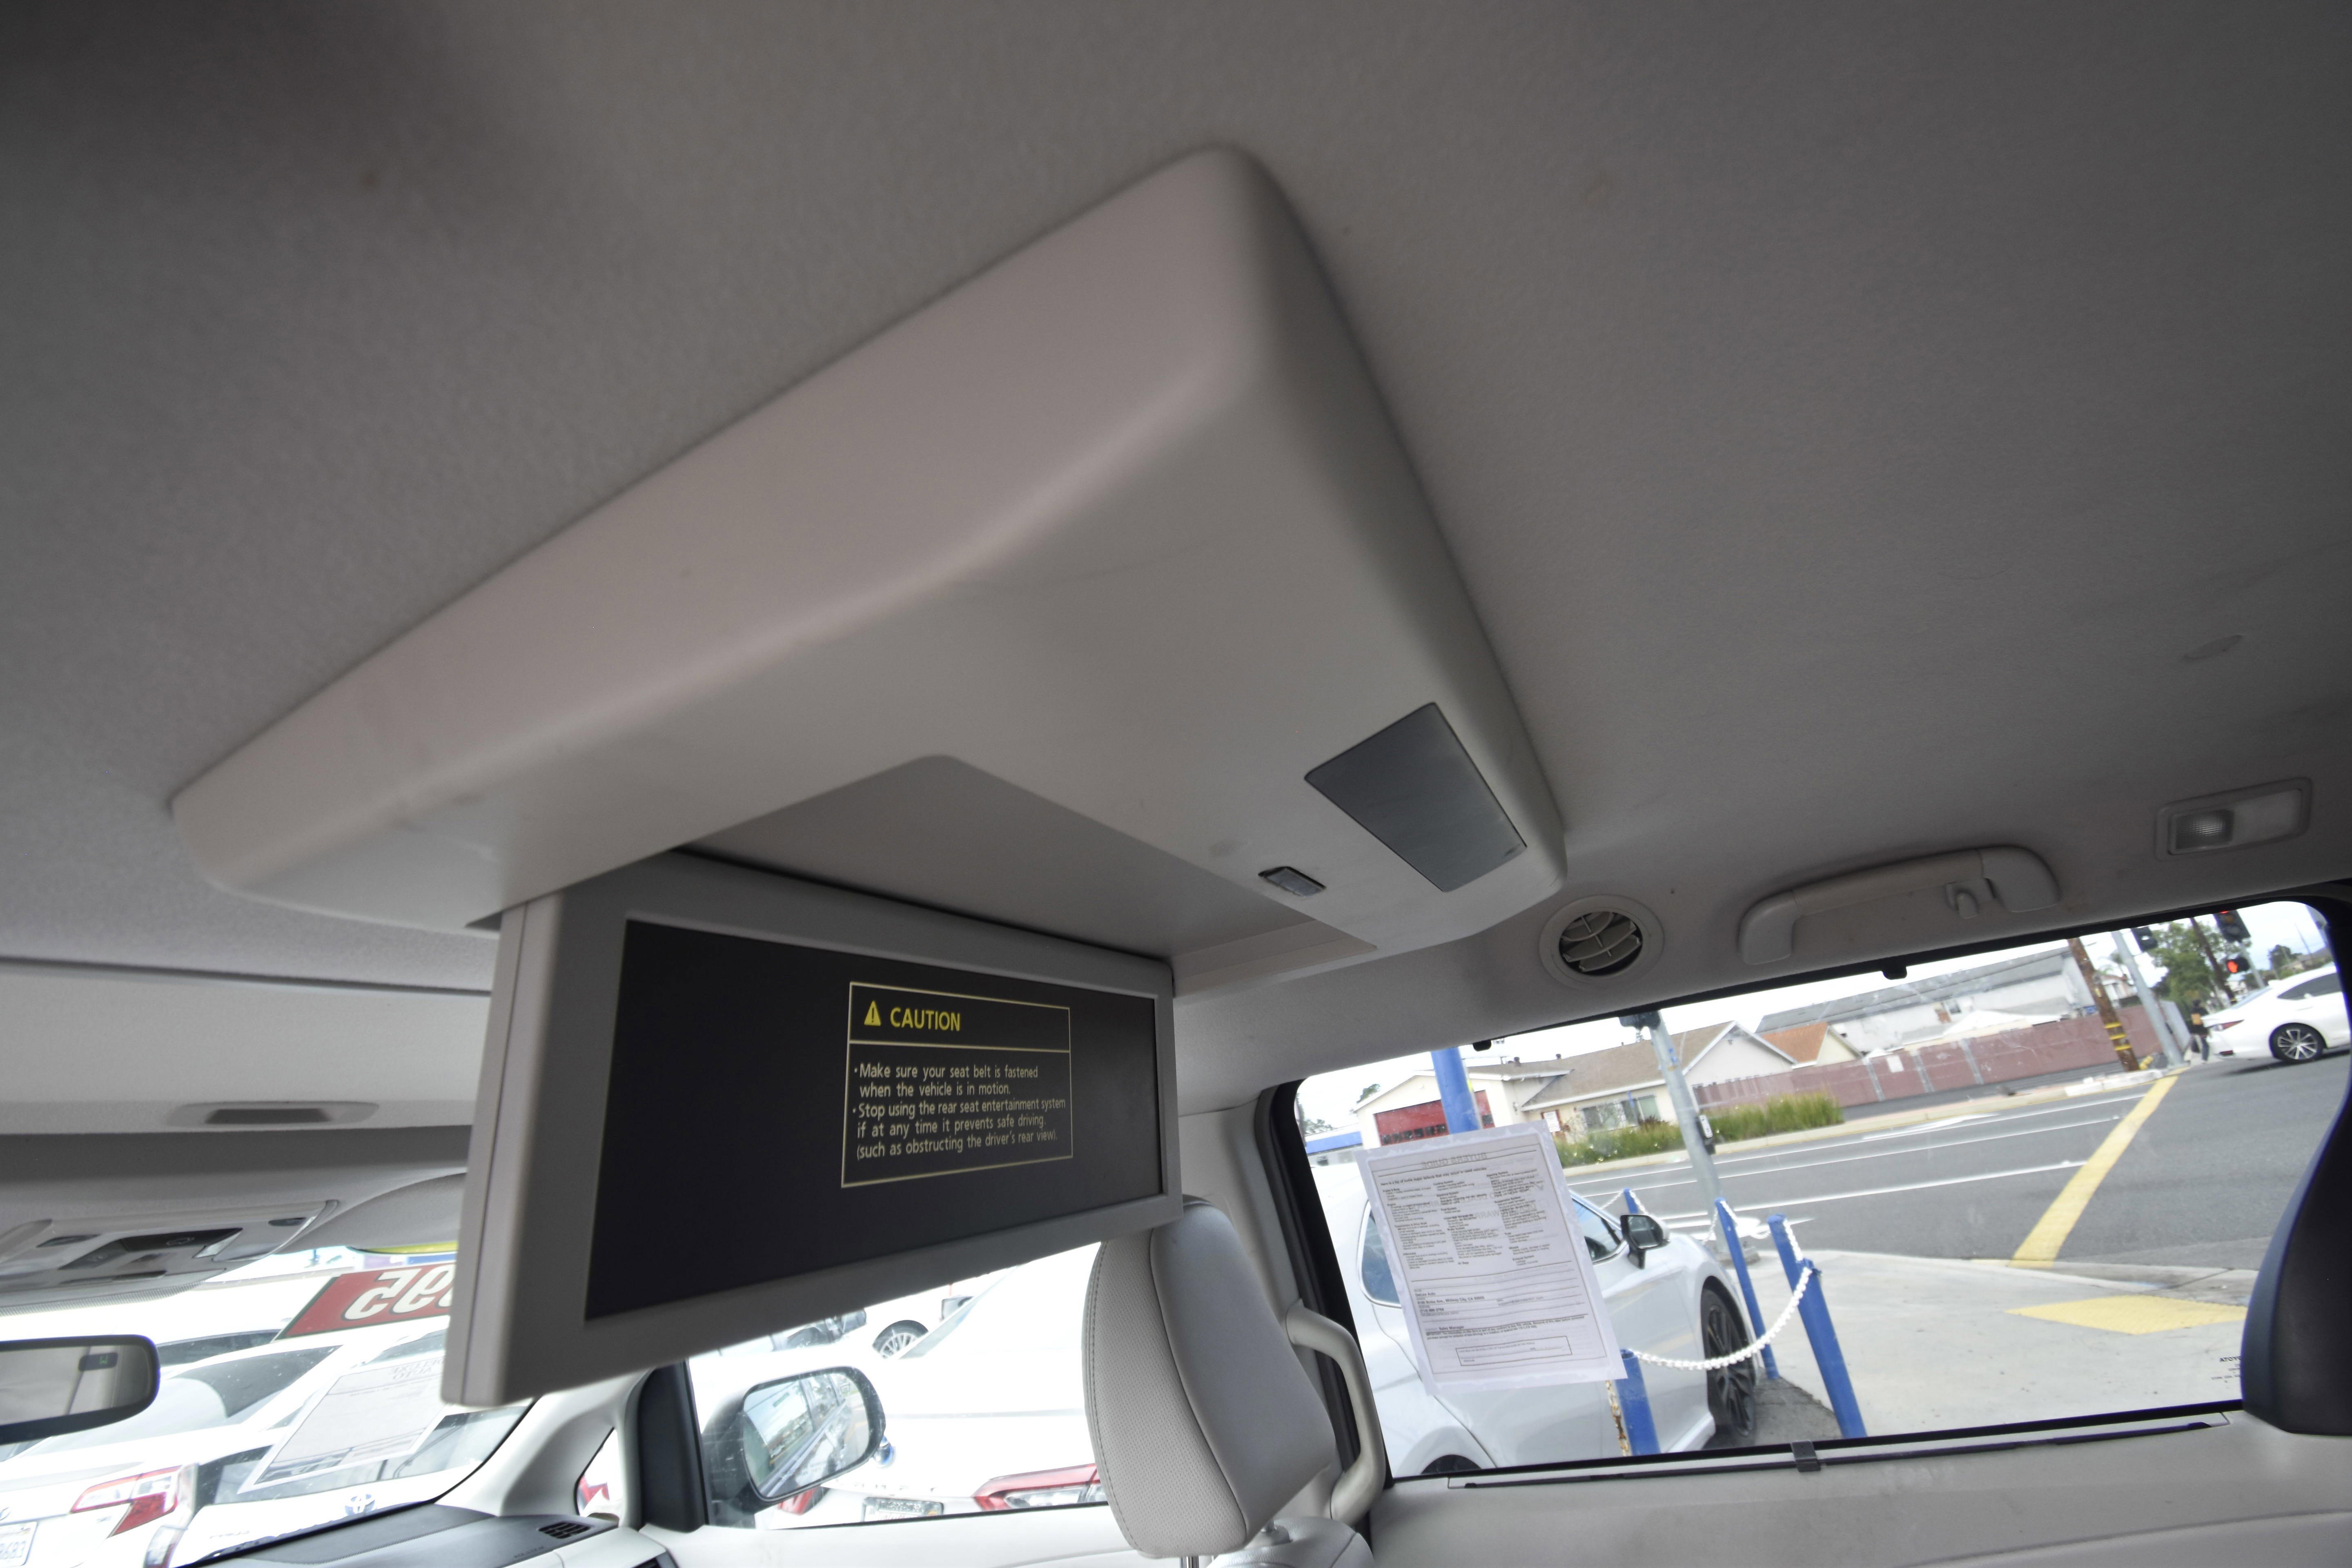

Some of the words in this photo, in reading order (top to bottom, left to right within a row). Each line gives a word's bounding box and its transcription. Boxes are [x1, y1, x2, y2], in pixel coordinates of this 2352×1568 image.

[890, 1007, 960, 1031] CAUTION
[860, 1063, 891, 1078] Make
[896, 1065, 917, 1078] sure
[923, 1065, 945, 1081] your
[950, 1065, 969, 1078] seat
[973, 1065, 990, 1078] belt
[995, 1065, 1000, 1078] is
[1004, 1065, 1038, 1078] fastened
[860, 1082, 891, 1097] when
[897, 1082, 913, 1097] the
[919, 1082, 951, 1096] vehicle
[957, 1082, 962, 1095] is
[967, 1082, 974, 1095] in
[979, 1082, 1010, 1094] motion.
[859, 1103, 884, 1120] Stop
[889, 1102, 915, 1119] using
[919, 1101, 935, 1115] the
[938, 1102, 956, 1114] rear
[960, 1101, 979, 1112] seat
[982, 1098, 1039, 1112] entertainment
[1042, 1099, 1065, 1109] system
[858, 1123, 866, 1138] if
[872, 1123, 884, 1136] at
[890, 1123, 909, 1137] any
[915, 1120, 937, 1134] time
[943, 1120, 949, 1132] it
[955, 1118, 993, 1134] prevents
[997, 1116, 1014, 1128] safe
[1018, 1114, 1046, 1129] driving.
[857, 1142, 885, 1160] (such
[890, 1144, 901, 1155] as
[906, 1136, 963, 1154] obstructing
[967, 1134, 981, 1148] the
[1018, 1130, 1033, 1143] rear
